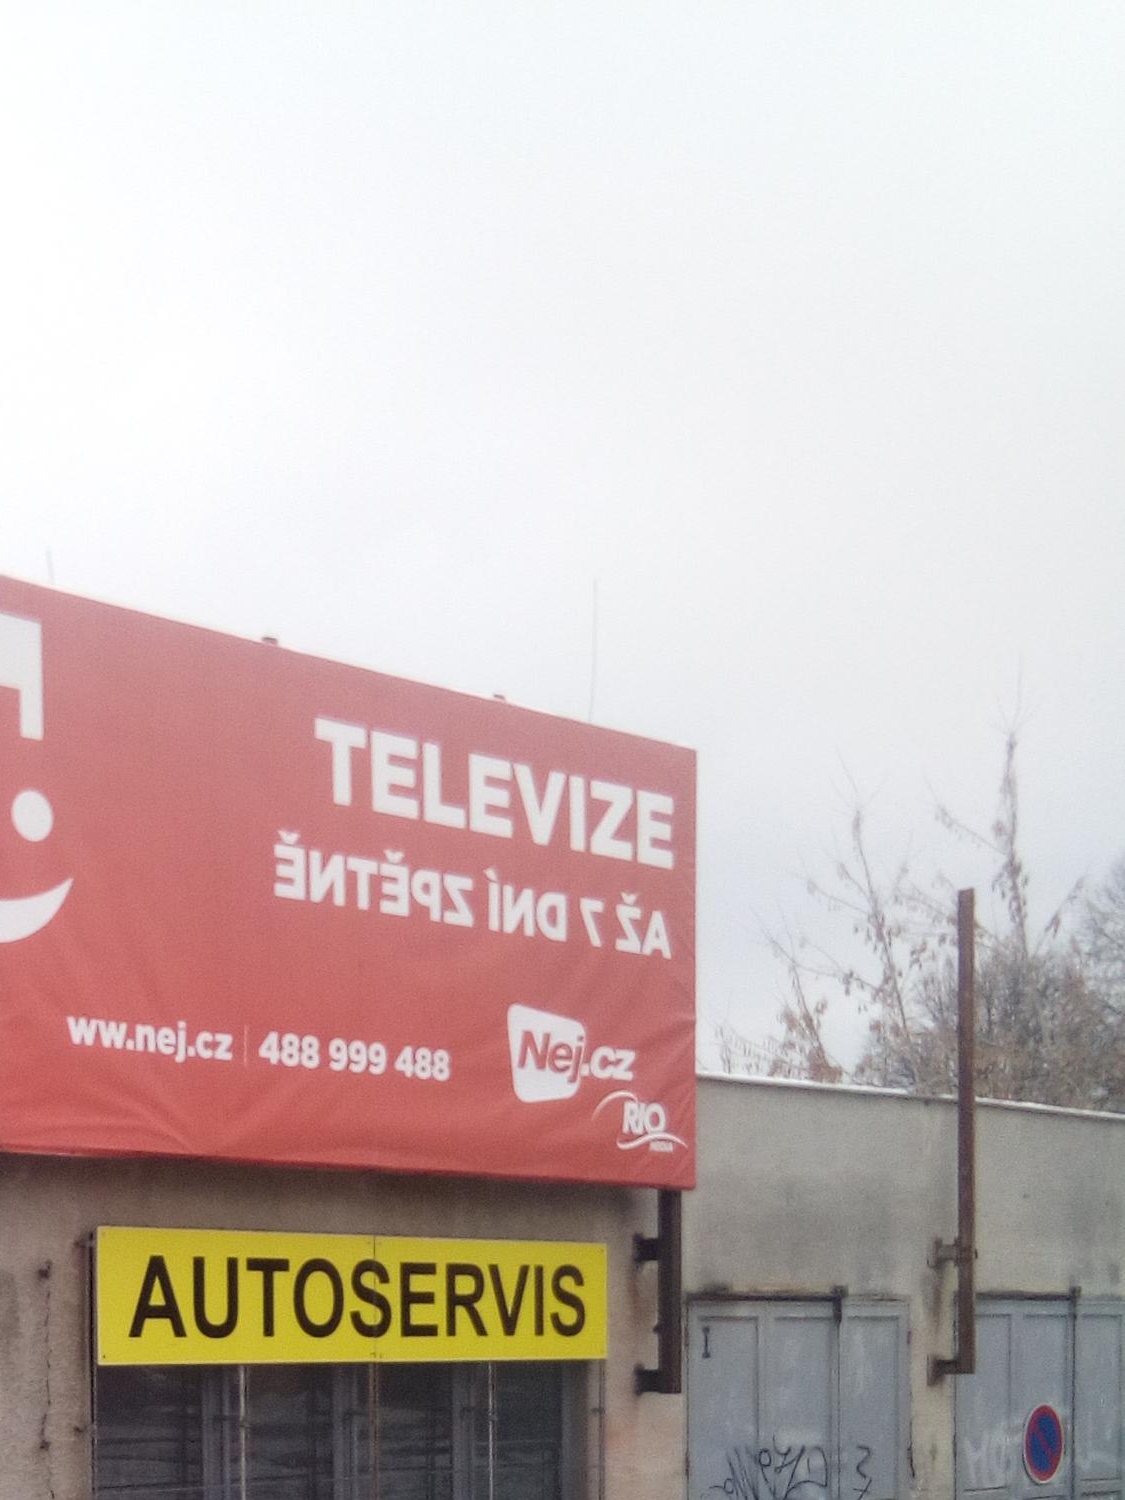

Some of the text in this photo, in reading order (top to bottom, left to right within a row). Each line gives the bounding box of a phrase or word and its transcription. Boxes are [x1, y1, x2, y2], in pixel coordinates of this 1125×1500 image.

[313, 715, 674, 870] TELEVIZE
[258, 1031, 320, 1069] 488
[328, 1038, 386, 1075] 999
[394, 1046, 451, 1082] 488
[517, 1030, 637, 1083] Nej.cz
[622, 1100, 666, 1135] RIO
[128, 1255, 587, 1338] AUTOSERVIS
